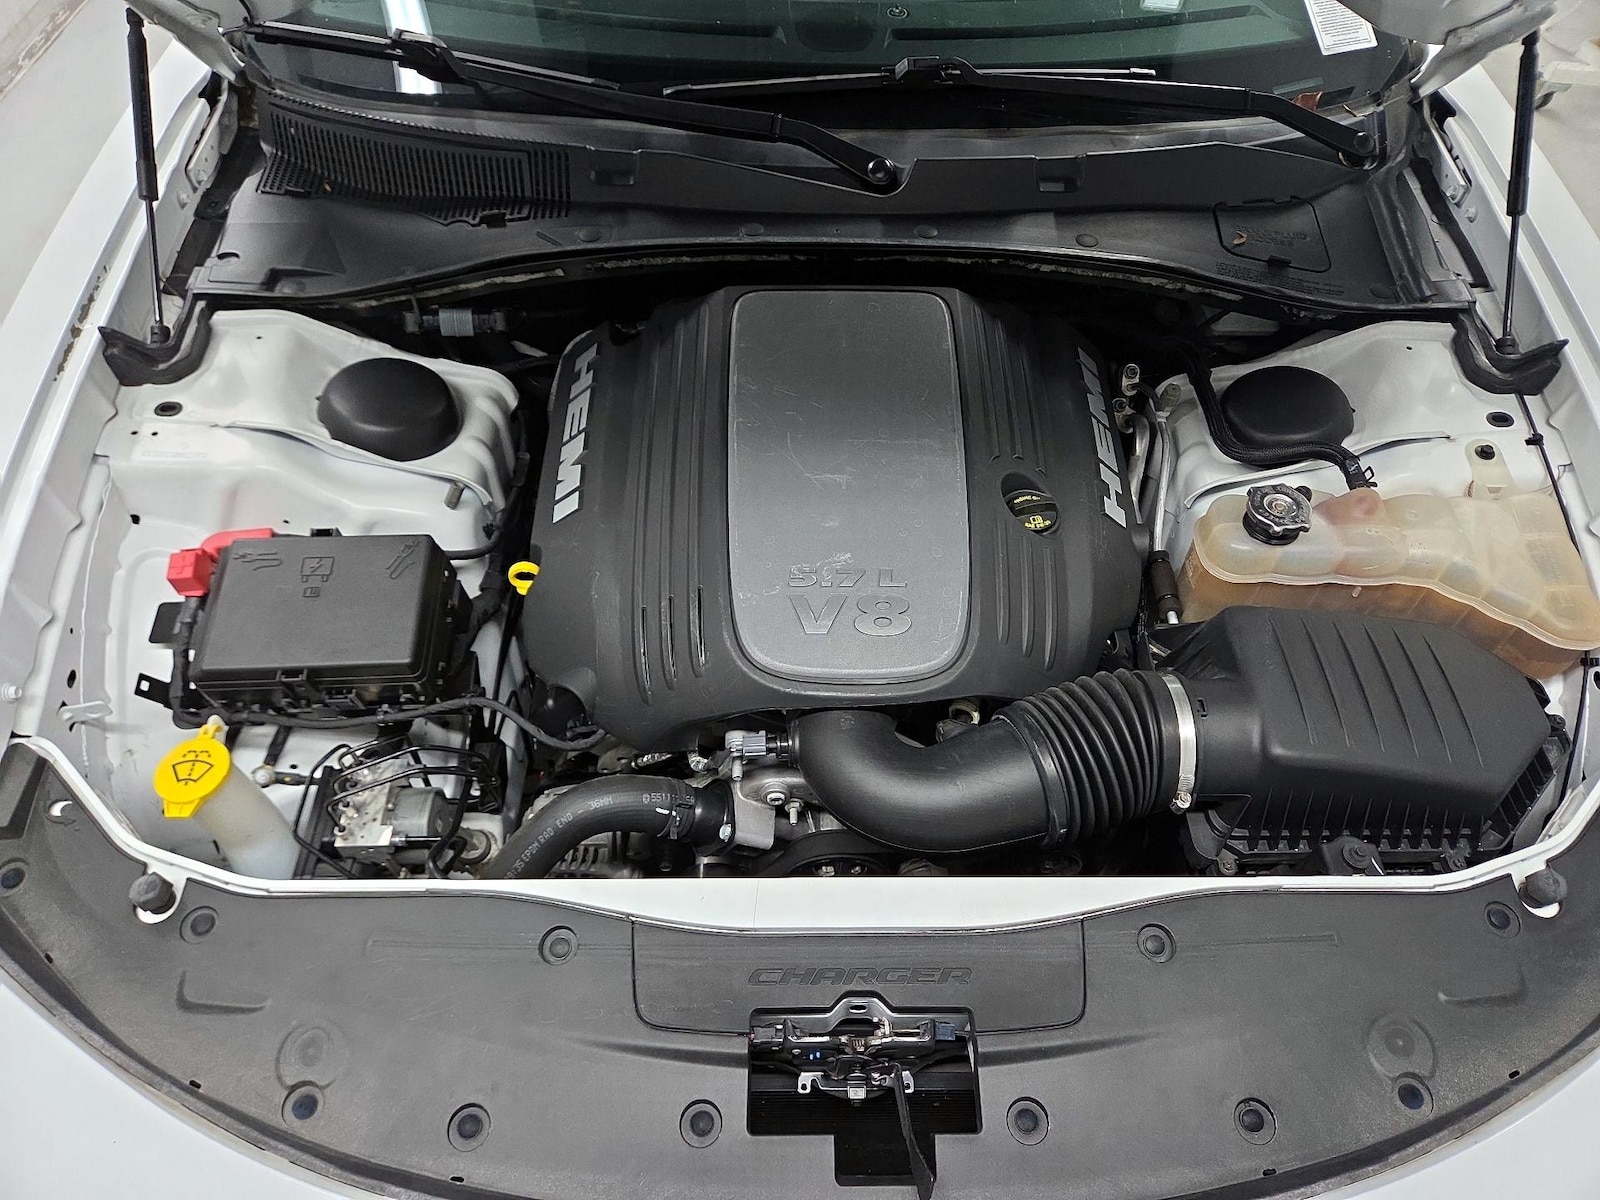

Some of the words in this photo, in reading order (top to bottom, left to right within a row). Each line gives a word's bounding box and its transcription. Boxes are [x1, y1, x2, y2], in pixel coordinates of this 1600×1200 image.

[552, 343, 598, 523] HEMI
[1077, 347, 1126, 528] HEMI
[789, 592, 912, 636] V8
[538, 827, 555, 845] RAD
[556, 812, 573, 828] END
[587, 795, 613, 810] 36MM
[748, 967, 973, 986] CHARGER
